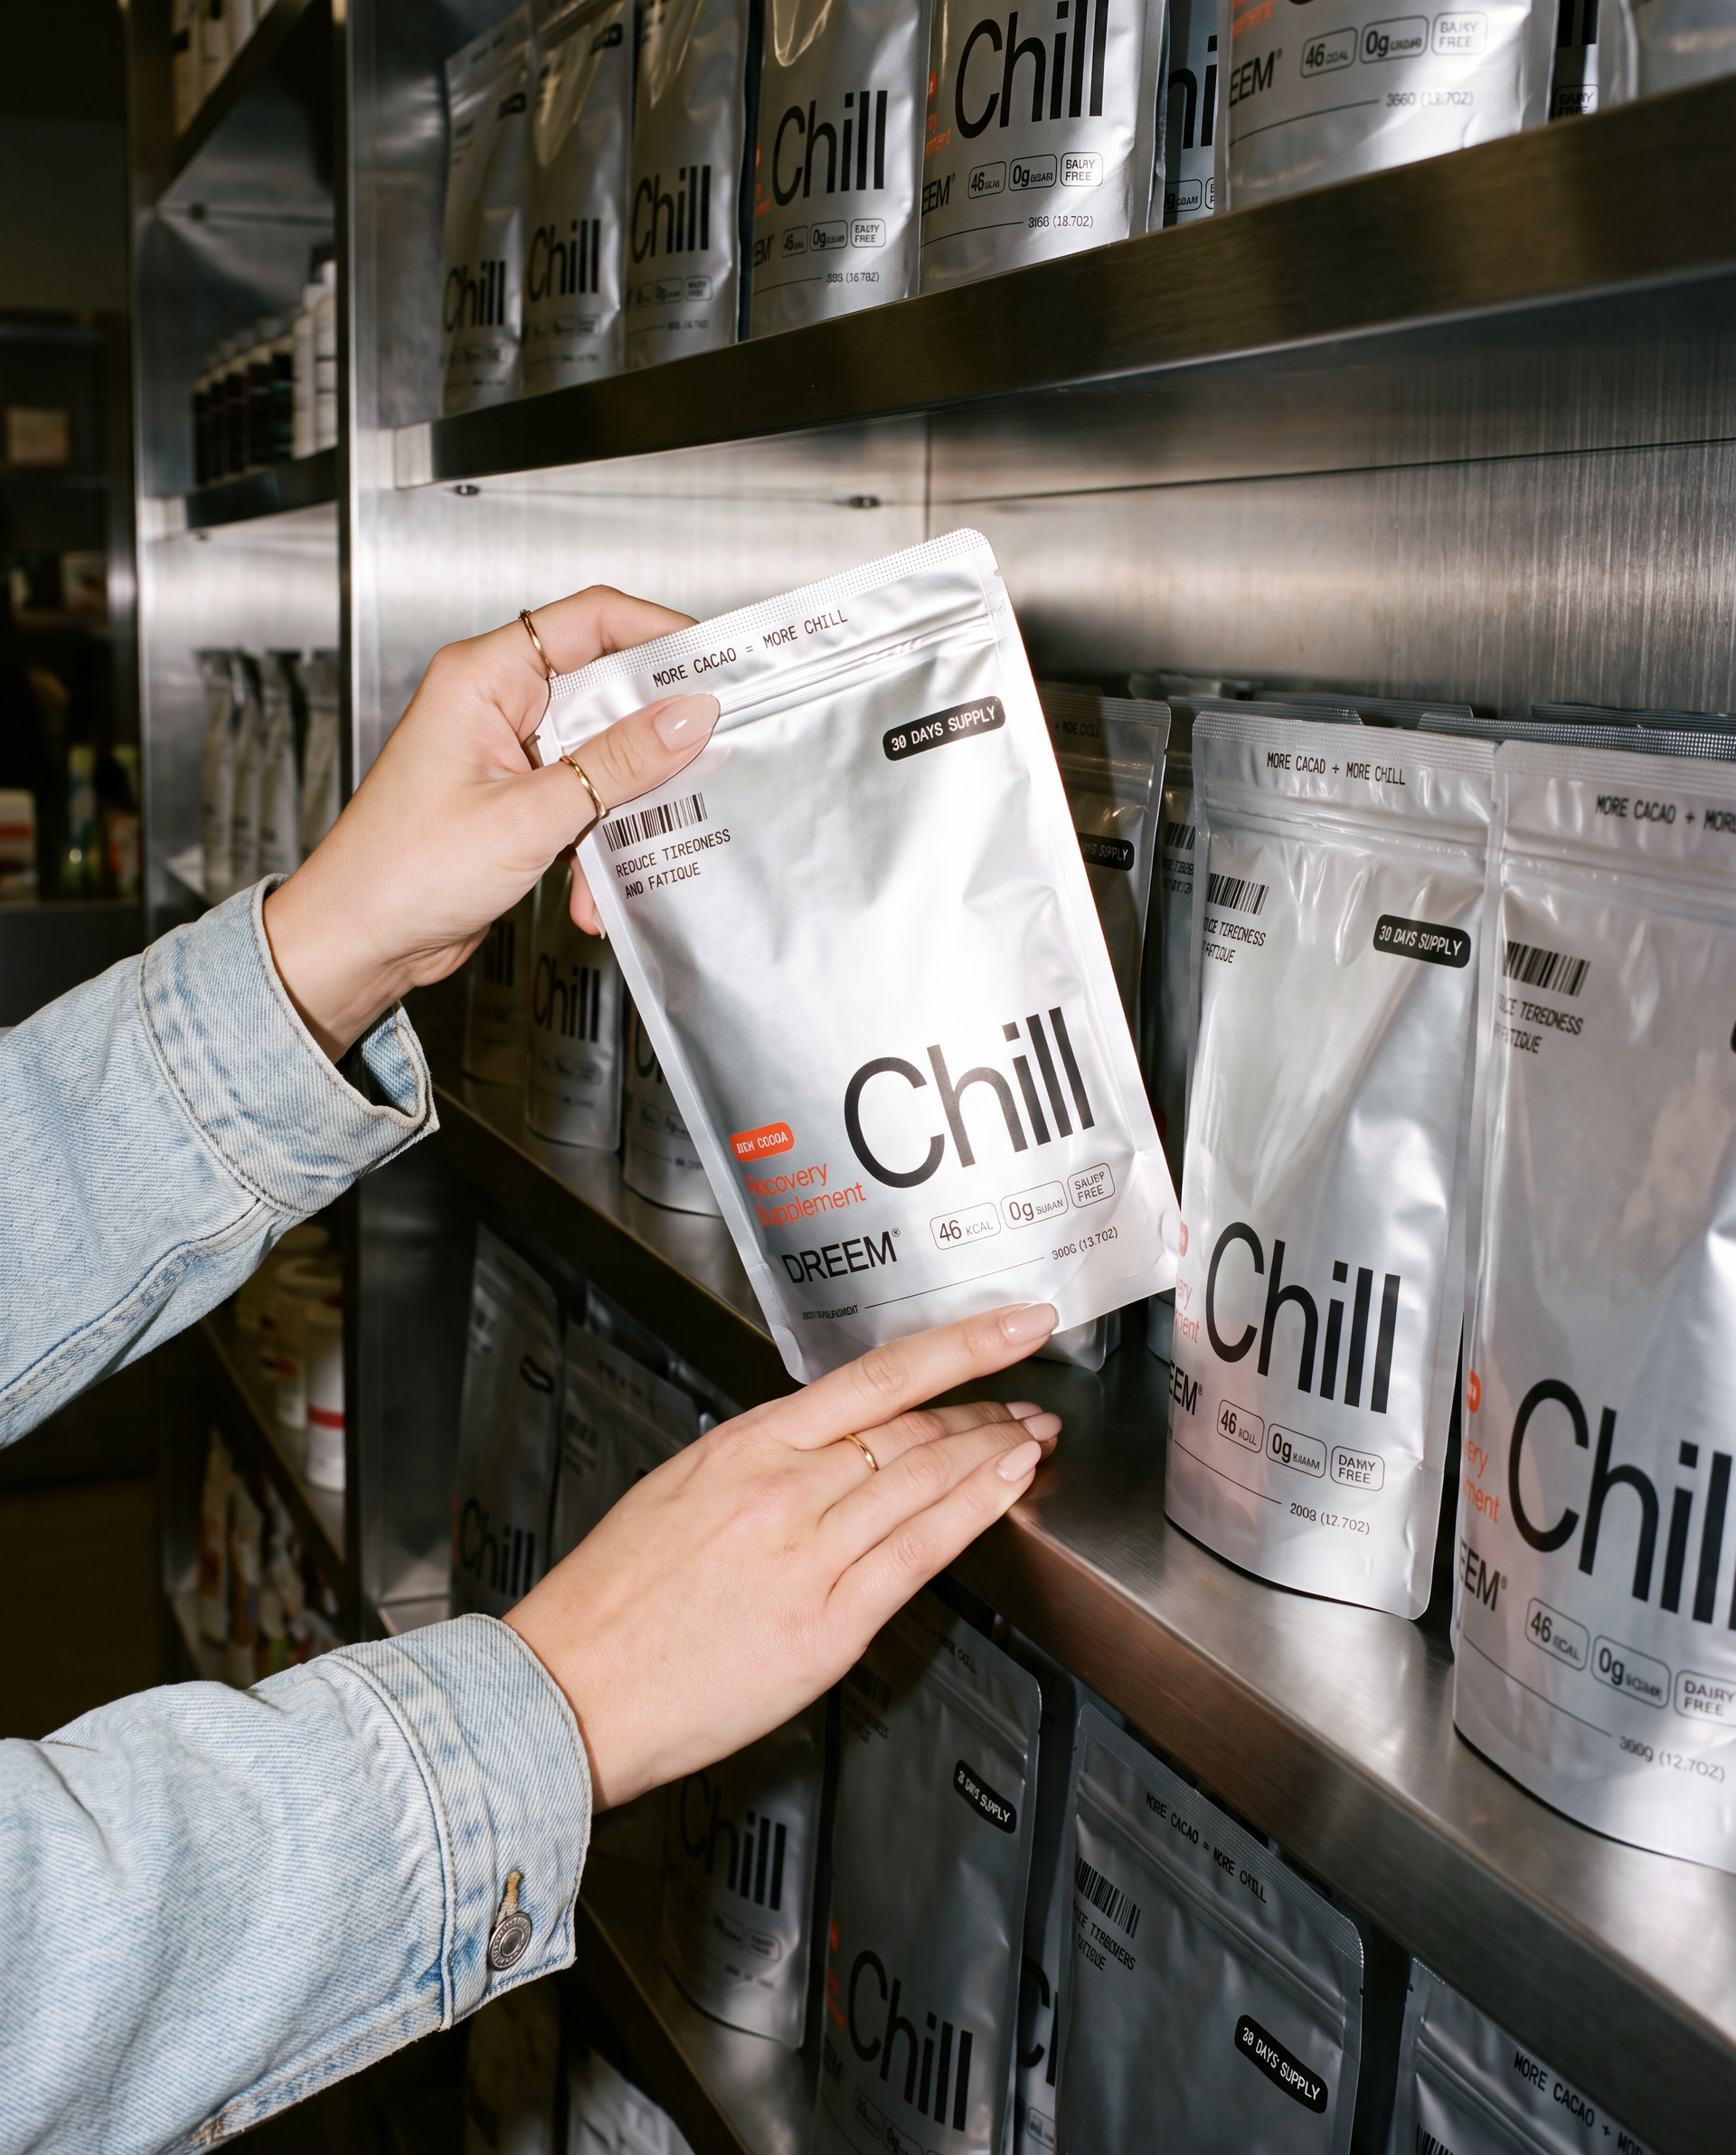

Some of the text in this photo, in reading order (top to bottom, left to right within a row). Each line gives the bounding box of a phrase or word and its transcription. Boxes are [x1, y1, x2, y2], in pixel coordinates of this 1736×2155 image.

[1306, 43, 1325, 67] 46
[1366, 31, 1390, 57] 0g
[1440, 36, 1473, 48] FREE
[955, 0, 1109, 138] Chill
[772, 90, 888, 206] Chill
[971, 172, 985, 192] 46
[1013, 165, 1030, 187] 0g
[1066, 171, 1092, 182] FREE
[633, 165, 711, 264] Chill
[814, 229, 826, 248] 0g
[854, 234, 877, 243] FREE
[528, 219, 599, 302] Chill
[442, 260, 505, 333] Chill
[652, 665, 688, 687] MORE
[693, 647, 737, 674] CACAO
[762, 626, 798, 649] MORE
[804, 610, 848, 634] CHILL
[892, 705, 995, 751] 30 DAYS SUPPLY
[1267, 751, 1291, 770] MORE
[1345, 761, 1371, 780] MORE
[1374, 766, 1406, 785] CHILL
[1596, 794, 1629, 818] MORE
[1634, 800, 1676, 825] CACAO
[616, 852, 657, 878] REDUCE
[625, 862, 701, 899] AND FATIQUE
[1379, 924, 1463, 957] 30 DAYS SUPPLY
[533, 952, 600, 1043] Chill
[844, 1006, 1095, 1188] Chill
[744, 1163, 827, 1197] Recovery
[1077, 1184, 1105, 1203] FREE
[755, 1181, 867, 1229] Supplement
[1008, 1201, 1035, 1222] 0g
[939, 1219, 995, 1242] 46 KCAL
[1205, 1222, 1401, 1414] Chill
[1221, 1409, 1237, 1434] 46
[1272, 1432, 1292, 1463] 0g
[1338, 1467, 1372, 1484] FREE
[1530, 1611, 1553, 1643] 46
[1599, 1647, 1625, 1686] 0g
[1684, 1680, 1736, 1703] DAIRY
[1684, 1697, 1725, 1716] FREE
[680, 1770, 787, 1911] Chill
[1171, 1813, 1199, 1844] CACAO
[848, 1950, 973, 2132] Chill
[1279, 2060, 1321, 2102] SUPPLY
[1514, 2051, 1548, 2093] MORE
[1552, 2083, 1595, 2128] CACAO
